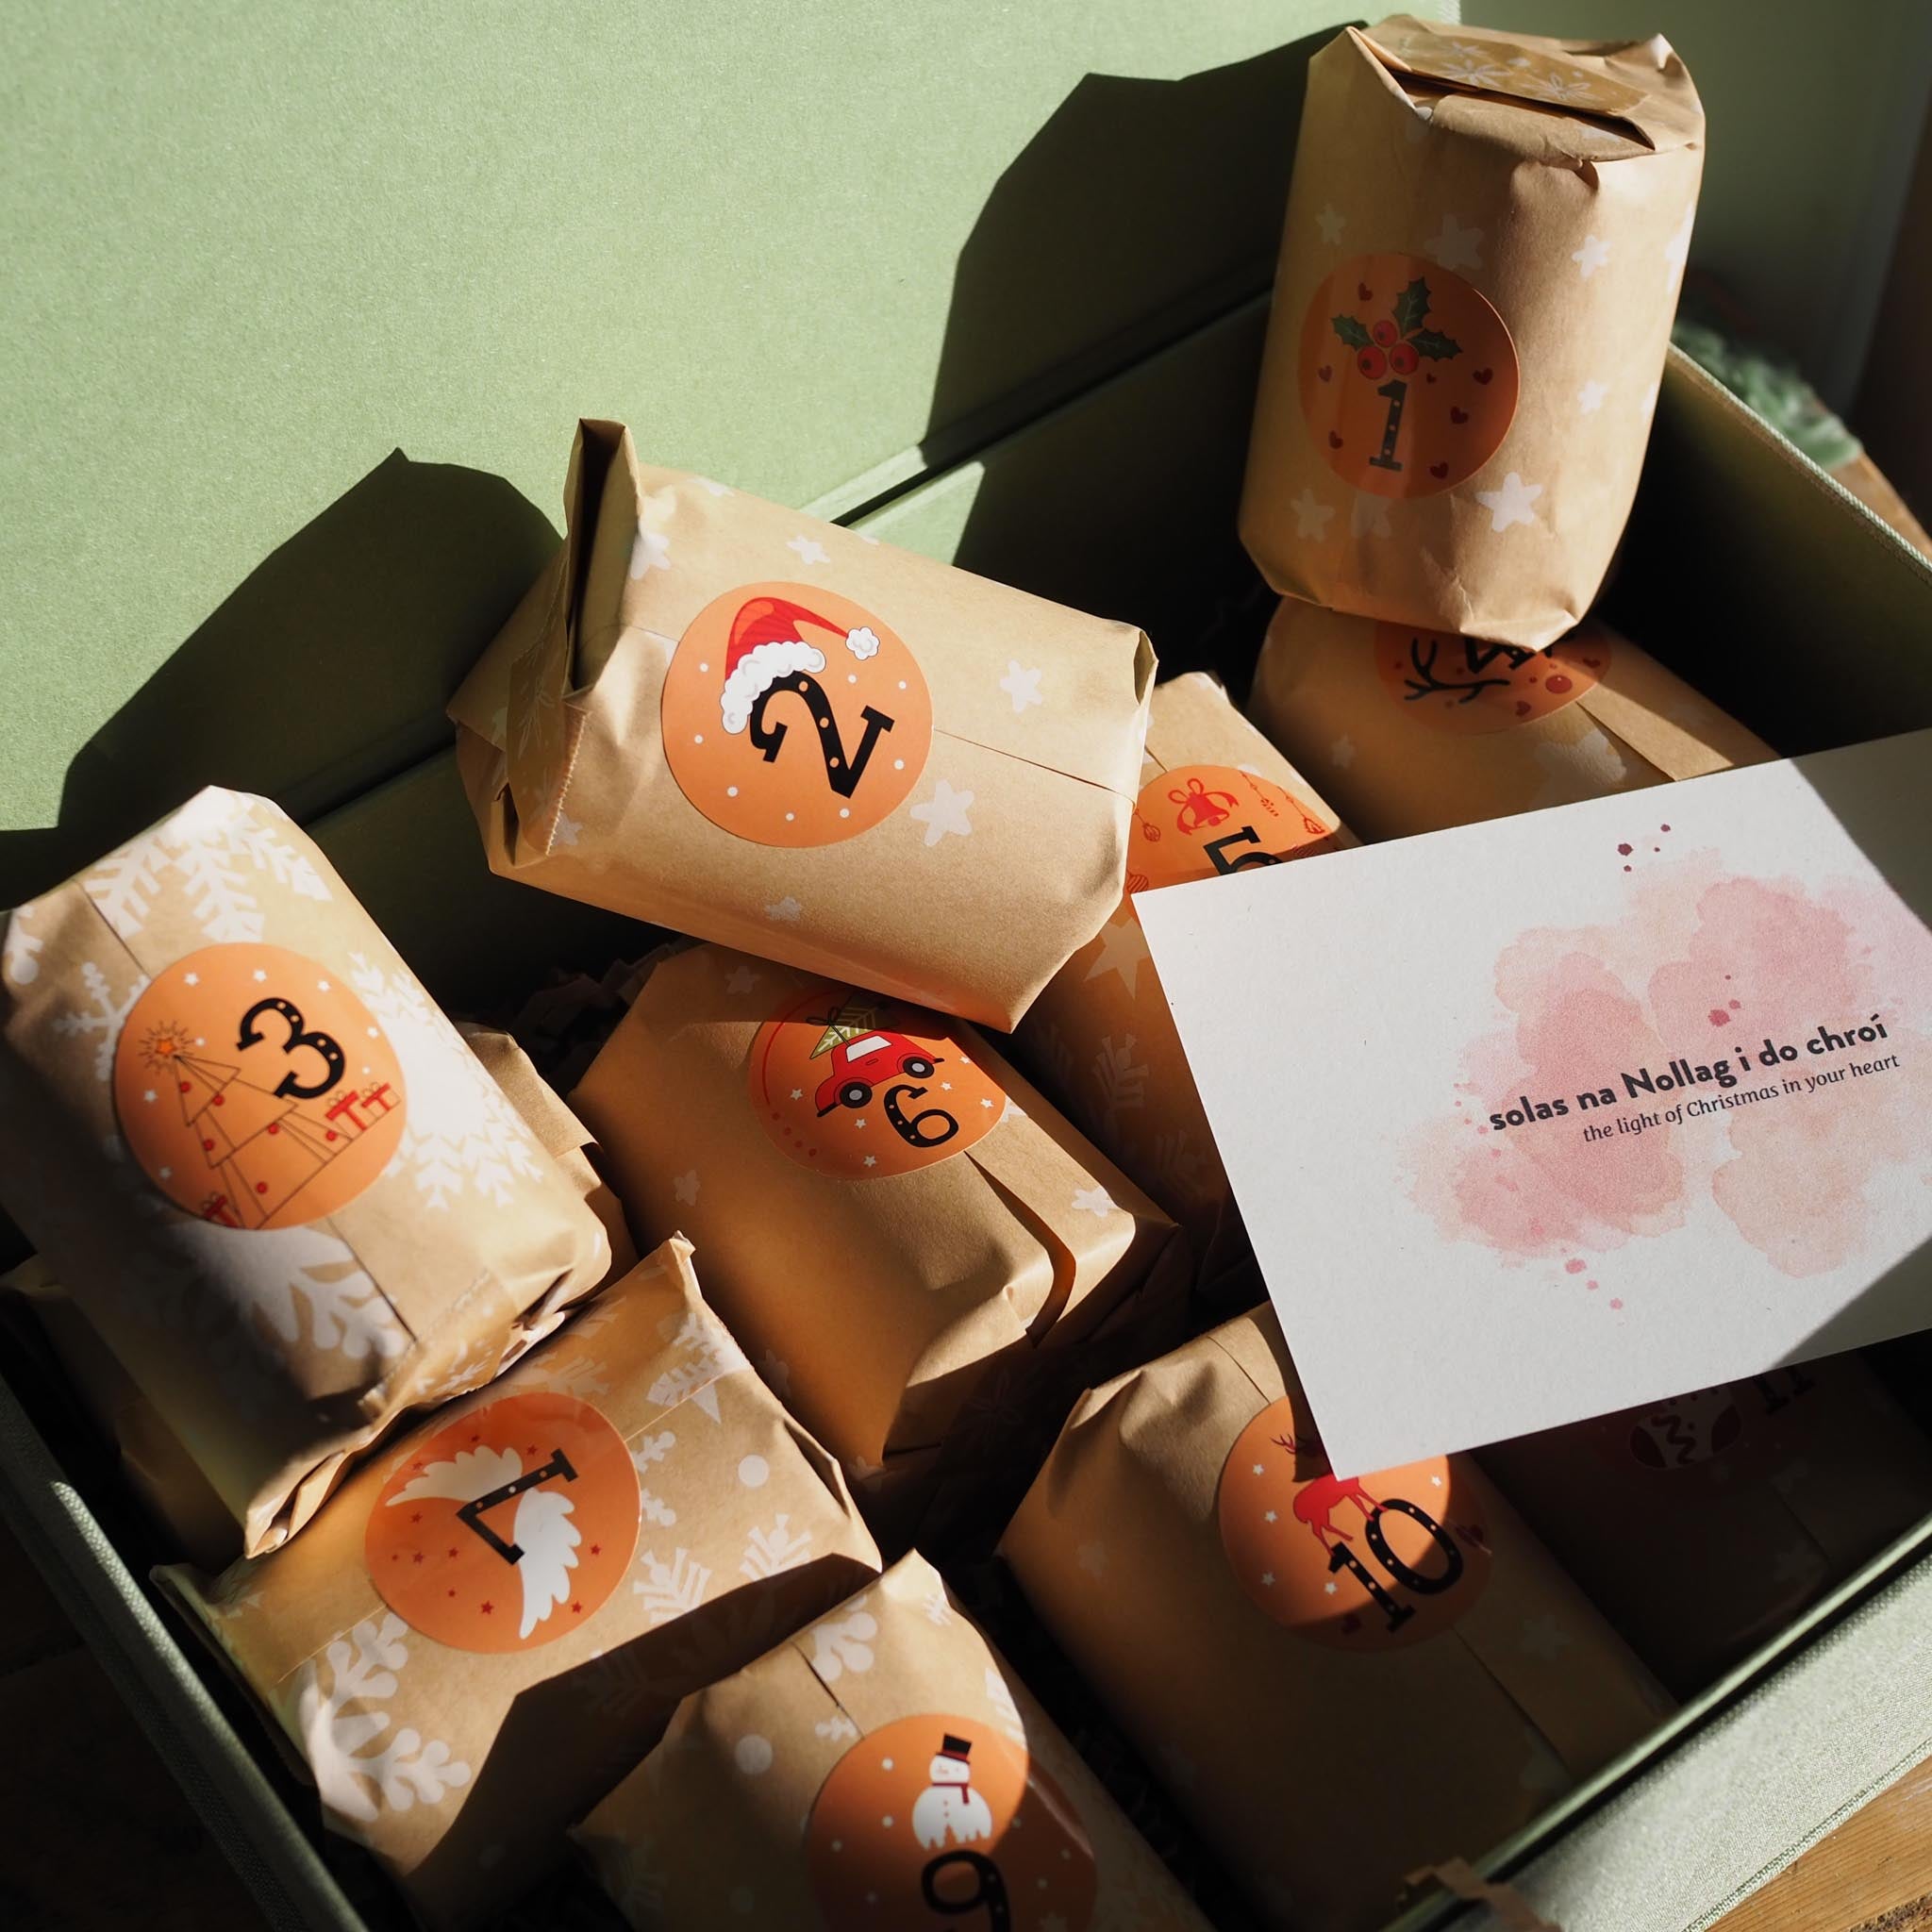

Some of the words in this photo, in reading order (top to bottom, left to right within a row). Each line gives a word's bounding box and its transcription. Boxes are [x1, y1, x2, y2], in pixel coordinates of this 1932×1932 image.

[1370, 379, 1407, 472] 1
[750, 670, 894, 799] 2
[236, 997, 345, 1099] 3
[1490, 1095, 1569, 1130] solas
[1576, 1088, 1617, 1109] na
[1621, 1058, 1738, 1098] Nollag
[1735, 1046, 1751, 1072] i
[1758, 1039, 1798, 1066] do
[1807, 1013, 1888, 1055] chroí
[1583, 1124, 1614, 1141] the
[1616, 1111, 1661, 1135] light
[1665, 1104, 1683, 1124] of
[1687, 1086, 1779, 1116] Christmas
[1782, 1078, 1802, 1094] in
[1805, 1069, 1845, 1092] your
[1849, 1055, 1900, 1077] heart
[883, 1084, 959, 1148] 6
[456, 1448, 578, 1566] 7
[1328, 1498, 1463, 1633] 10
[922, 1850, 1011, 1932] 9
